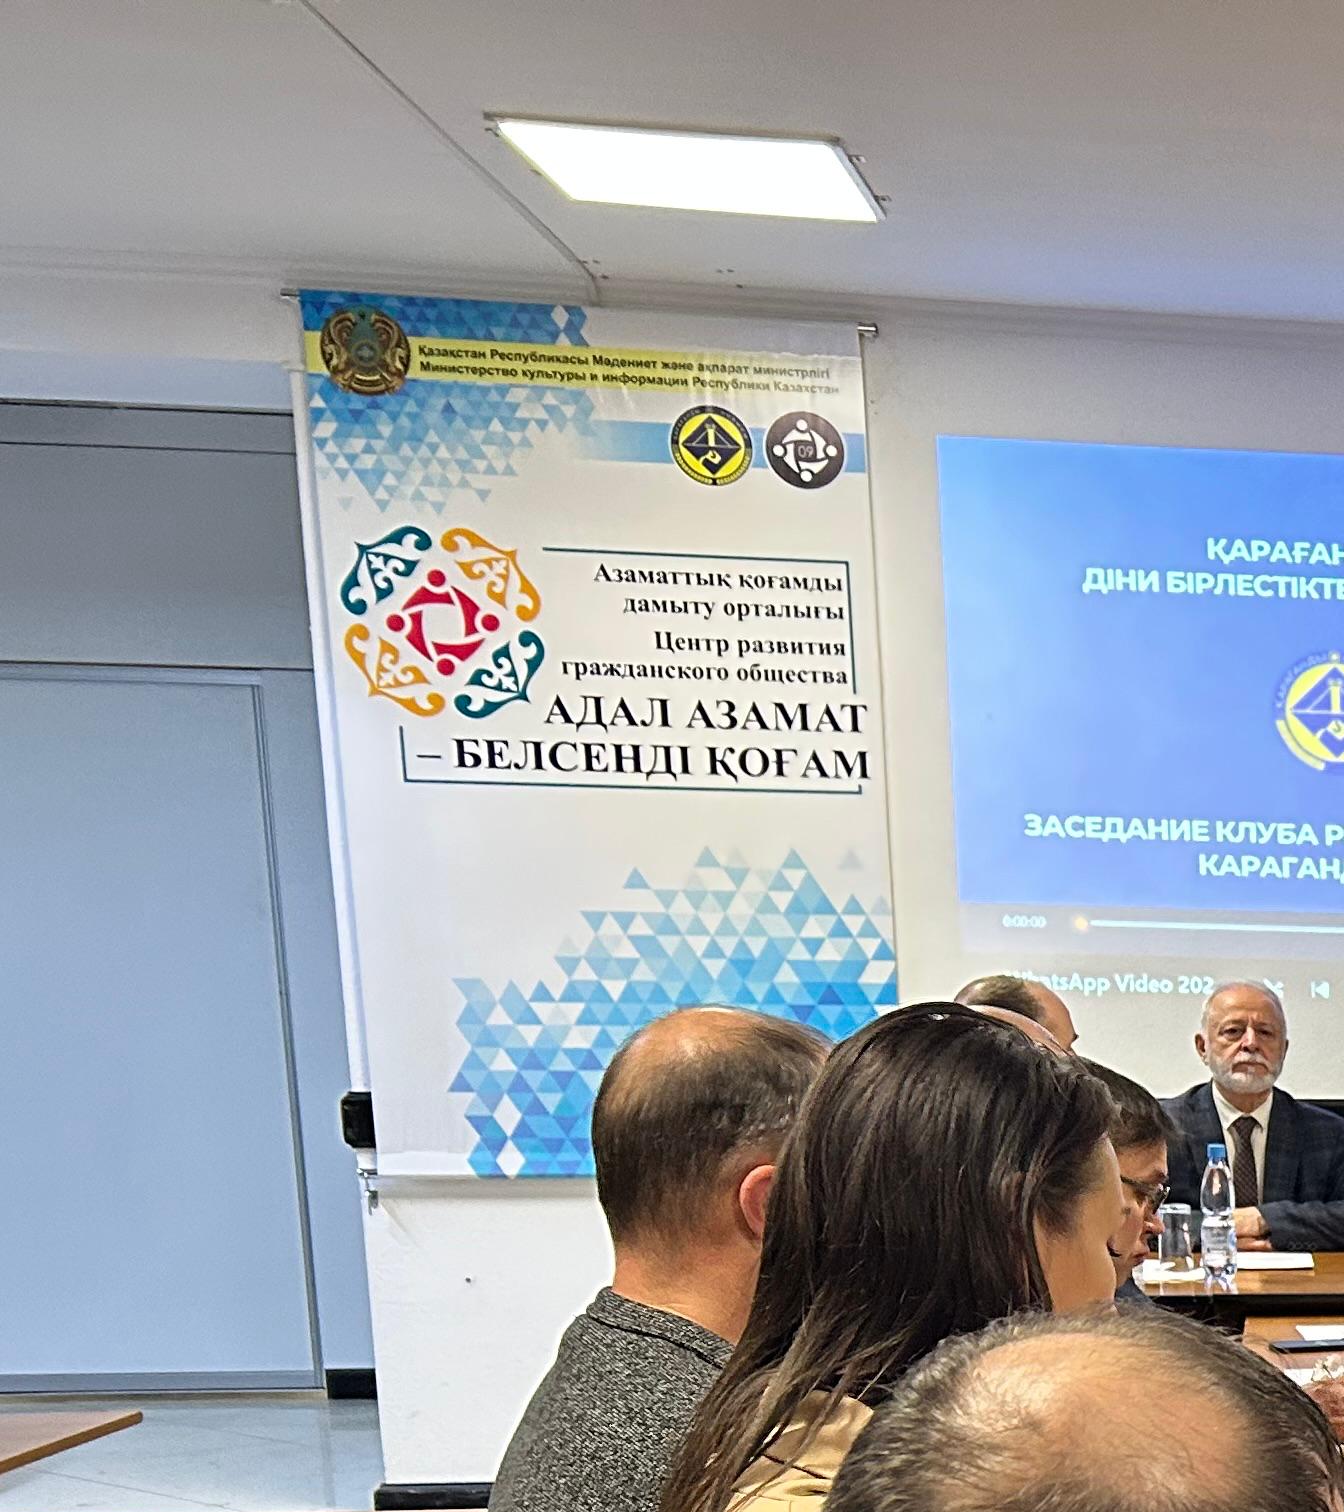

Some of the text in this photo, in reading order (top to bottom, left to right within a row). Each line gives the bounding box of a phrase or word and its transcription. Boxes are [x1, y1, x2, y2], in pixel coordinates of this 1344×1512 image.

[418, 344, 487, 360] Қазақстан
[490, 348, 589, 366] Республикасы
[593, 354, 657, 370] Мәдениет
[661, 360, 694, 371] және
[697, 361, 749, 375] ақпарат
[419, 361, 840, 395] Министерство культуры и информации Республики Казахстан
[594, 563, 843, 594] Азаматтық қоғамды
[1082, 566, 1160, 595] ДІНИ
[623, 597, 845, 622] дамыту орталығы
[654, 630, 846, 659] Центр развития
[561, 660, 848, 686] гражданского общества
[544, 694, 868, 735] АДАЛ АЗАМАТ
[452, 737, 695, 778] БЕЛСЕНДІ
[708, 747, 871, 783] ҚОҒАМ
[1023, 812, 1210, 844] ЗАСЕДАНИЕ
[1215, 820, 1319, 847] КЛУБА
[1114, 972, 1174, 994] Video
